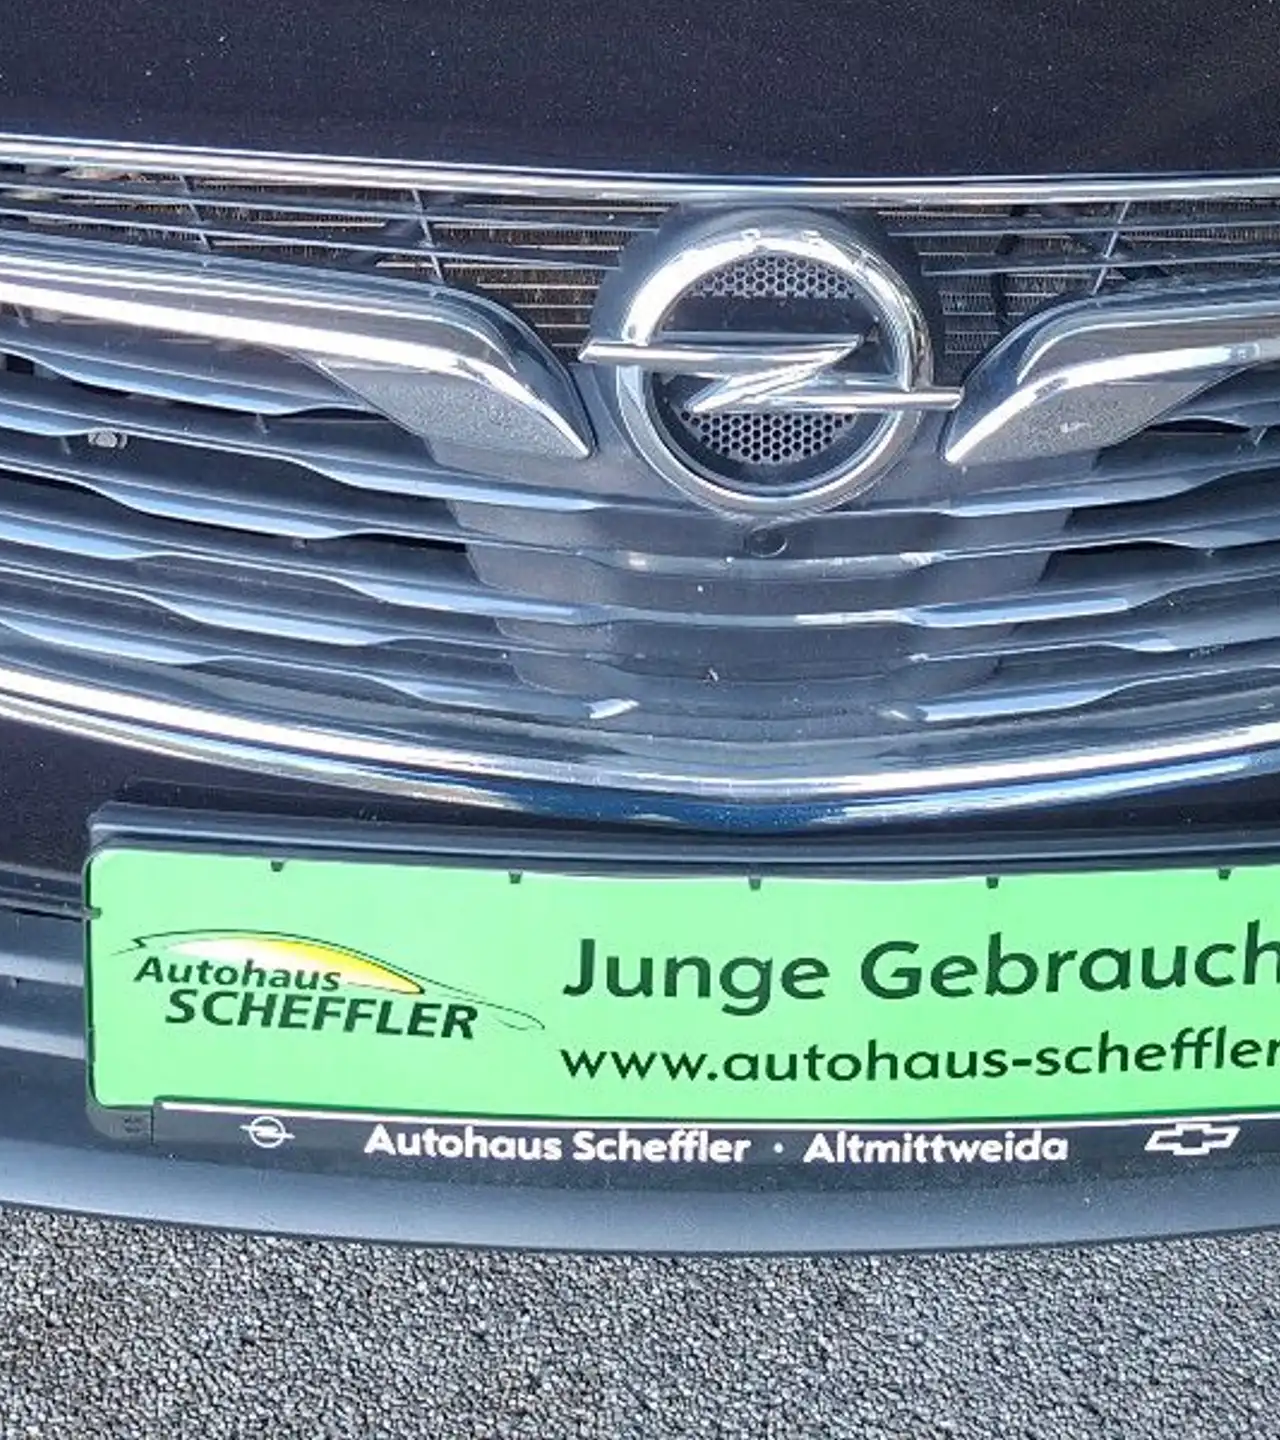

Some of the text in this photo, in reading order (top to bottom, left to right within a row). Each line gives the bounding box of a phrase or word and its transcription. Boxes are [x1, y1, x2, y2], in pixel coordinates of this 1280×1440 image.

[133, 956, 341, 991] Autohaus
[562, 938, 830, 1017] Junge
[165, 988, 478, 1039] SCHEFFLER
[363, 1124, 1069, 1164] Autohaus Scheffler Altmittweida
